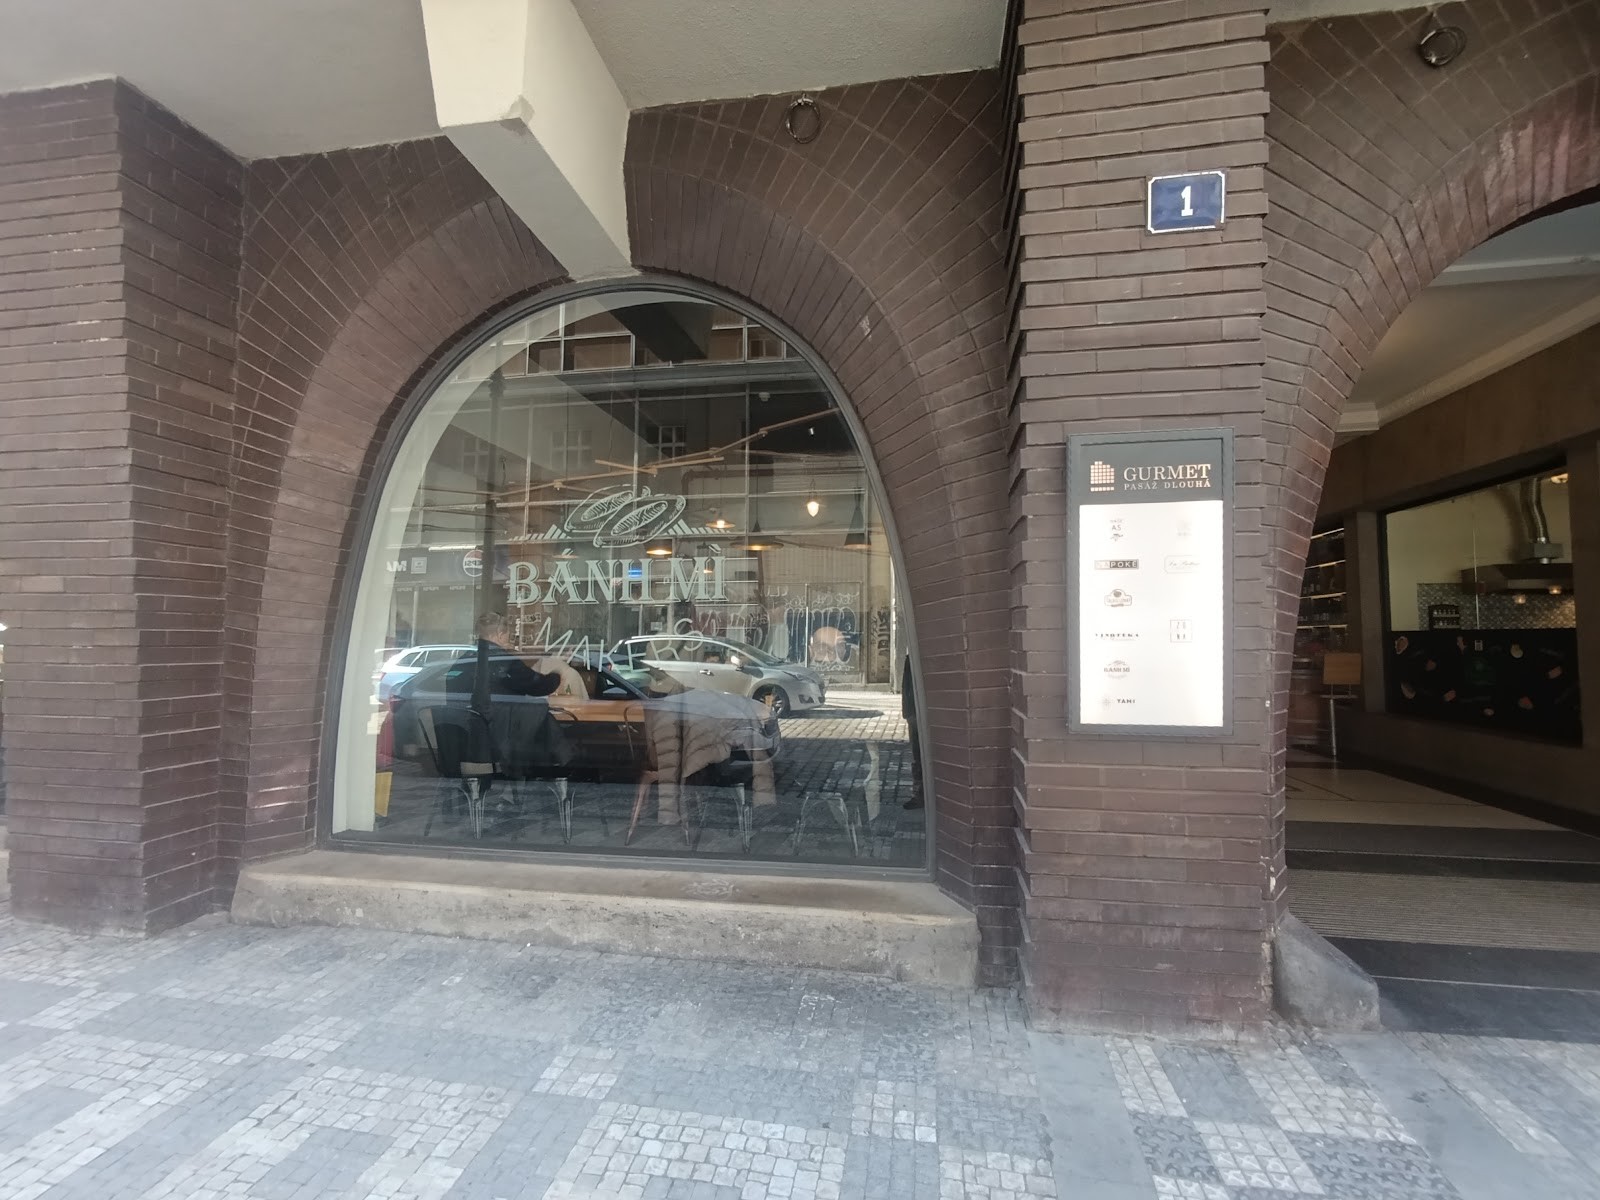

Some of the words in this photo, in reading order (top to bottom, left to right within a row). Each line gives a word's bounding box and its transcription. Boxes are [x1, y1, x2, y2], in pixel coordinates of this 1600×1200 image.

[1181, 185, 1193, 217] 1
[1123, 464, 1211, 481] GURMET
[1164, 479, 1211, 489] DLOUHÁ
[507, 548, 653, 605] BÁNH
[534, 617, 704, 673] MAKERS
